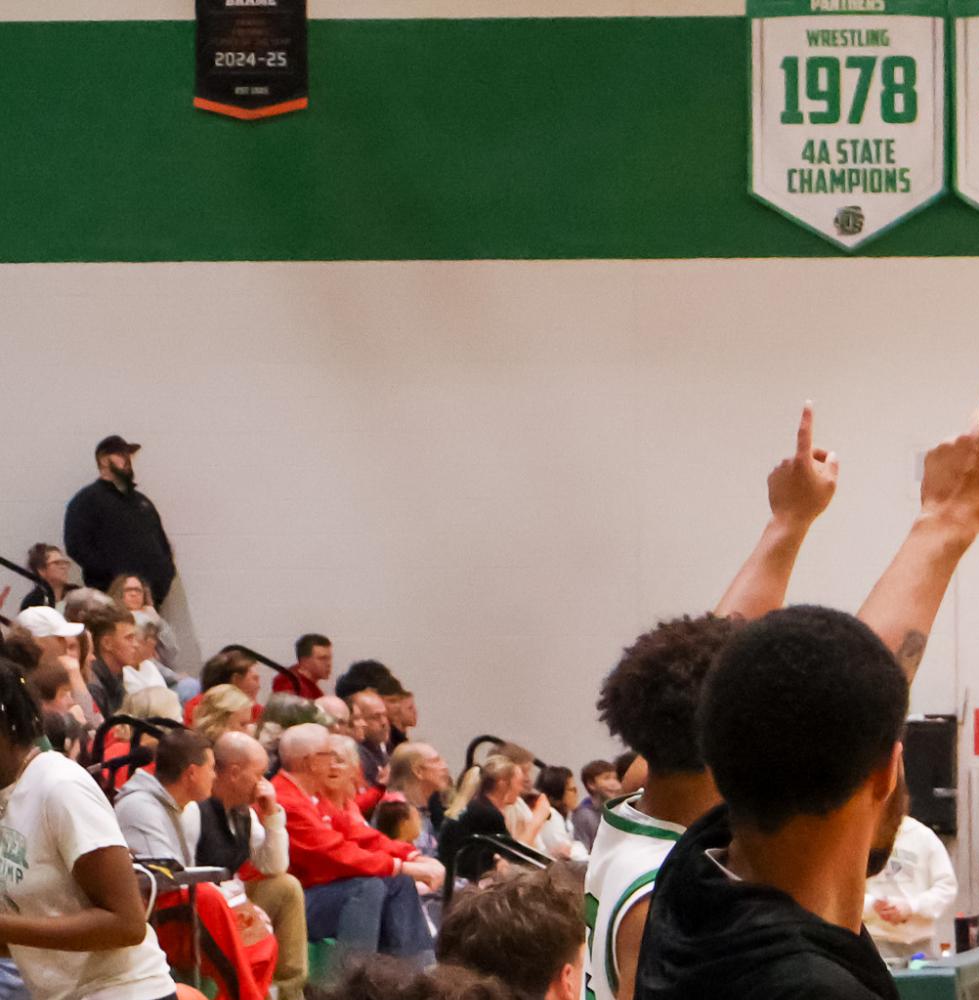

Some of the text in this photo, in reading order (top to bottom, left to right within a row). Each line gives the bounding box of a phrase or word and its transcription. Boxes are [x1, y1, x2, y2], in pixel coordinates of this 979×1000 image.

[806, 29, 890, 48] WRESTLING
[214, 51, 288, 68] 2024-25
[780, 55, 918, 125] 1978
[801, 139, 896, 165] 4A STATE
[787, 167, 911, 194] CHAMPIONS
